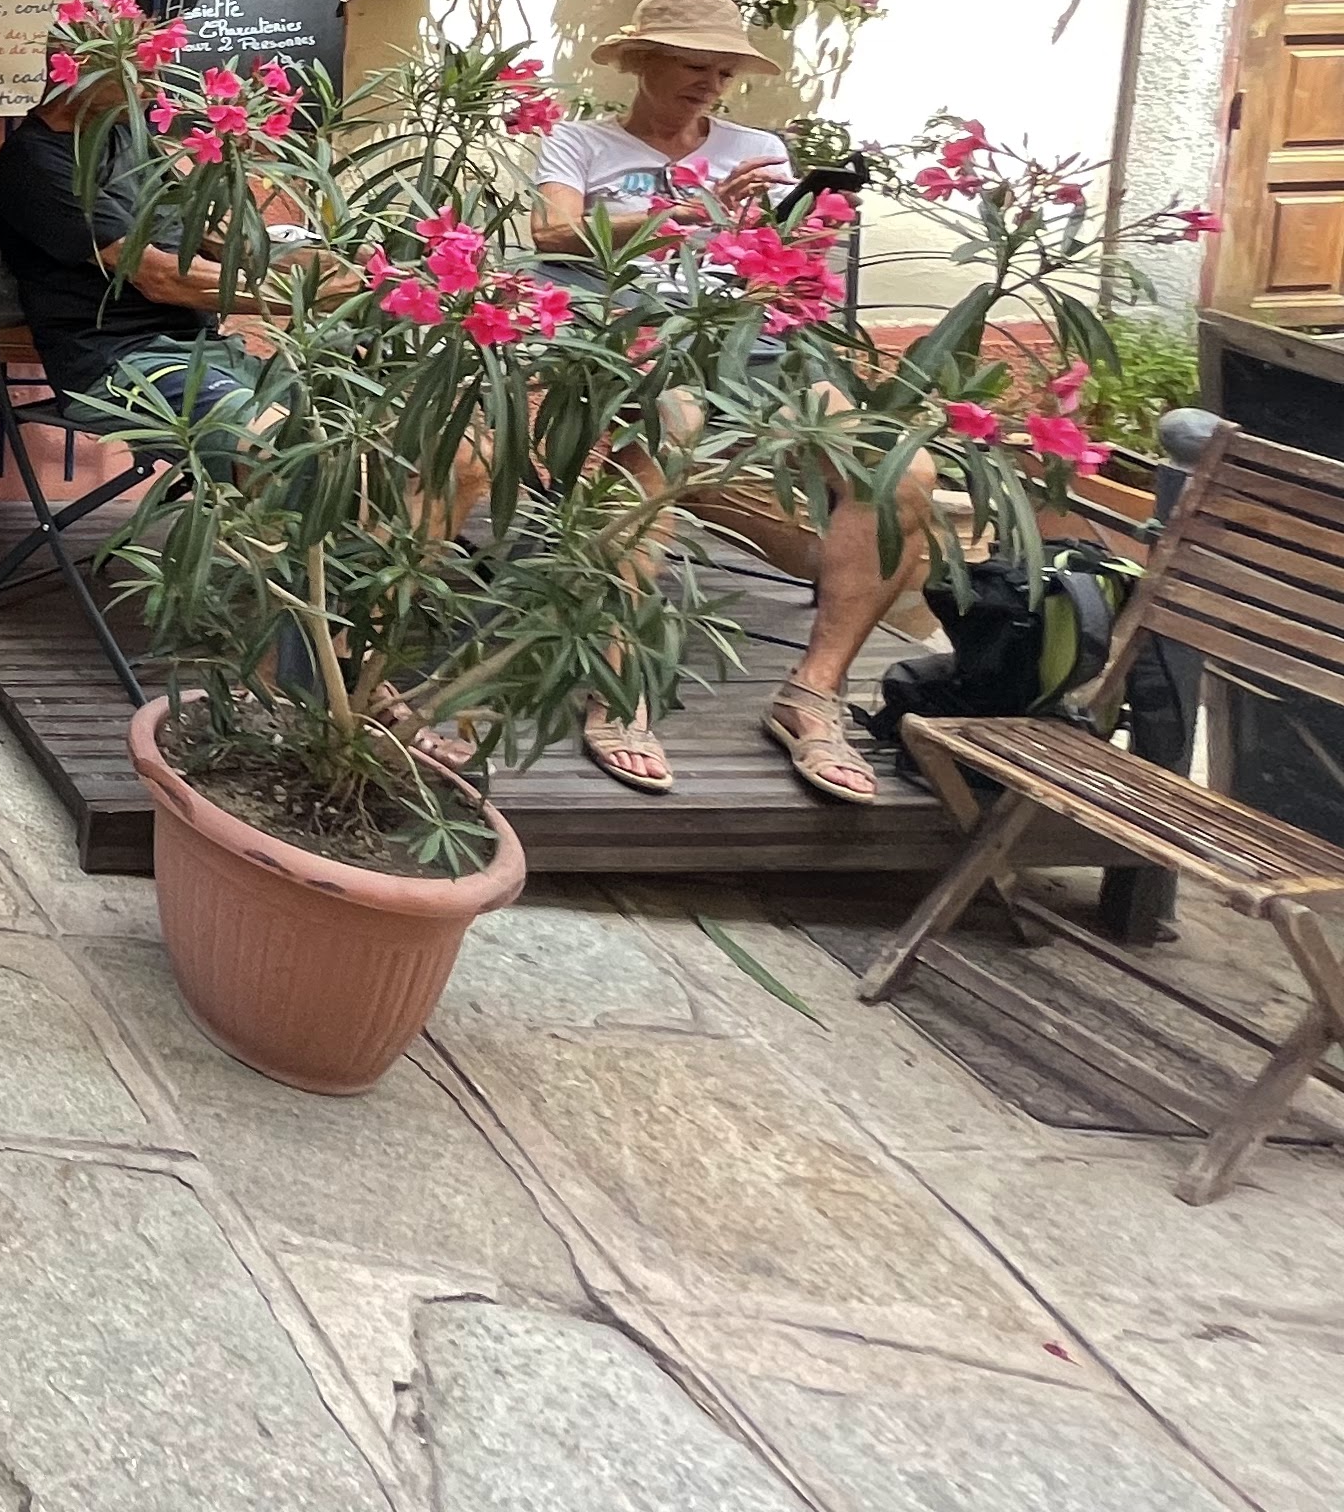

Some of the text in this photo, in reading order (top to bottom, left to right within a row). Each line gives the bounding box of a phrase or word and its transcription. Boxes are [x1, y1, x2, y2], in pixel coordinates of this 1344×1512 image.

[198, 18, 302, 39] Charcuteries
[9, 45, 26, 55] de
[217, 36, 234, 52] 2
